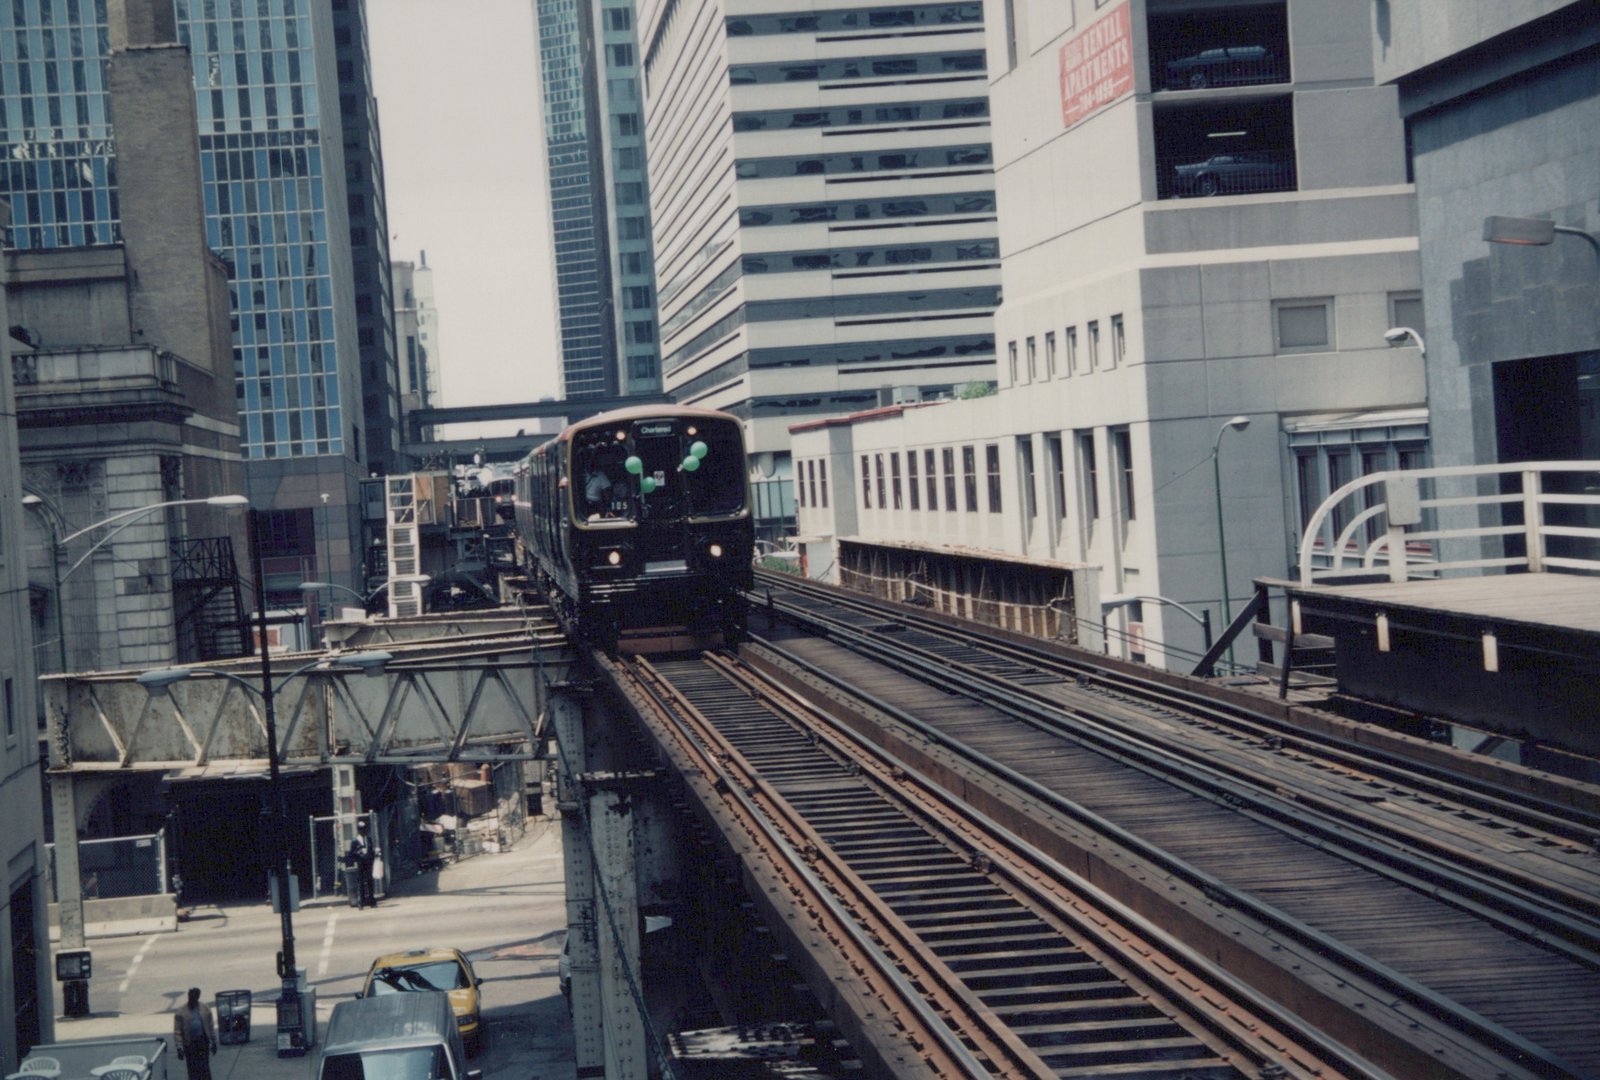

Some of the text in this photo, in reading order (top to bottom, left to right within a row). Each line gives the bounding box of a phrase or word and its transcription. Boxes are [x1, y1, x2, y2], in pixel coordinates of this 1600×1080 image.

[1082, 11, 1122, 61] RENTAL
[1064, 37, 1129, 101] APARTMENTS
[641, 425, 672, 434] Chartered
